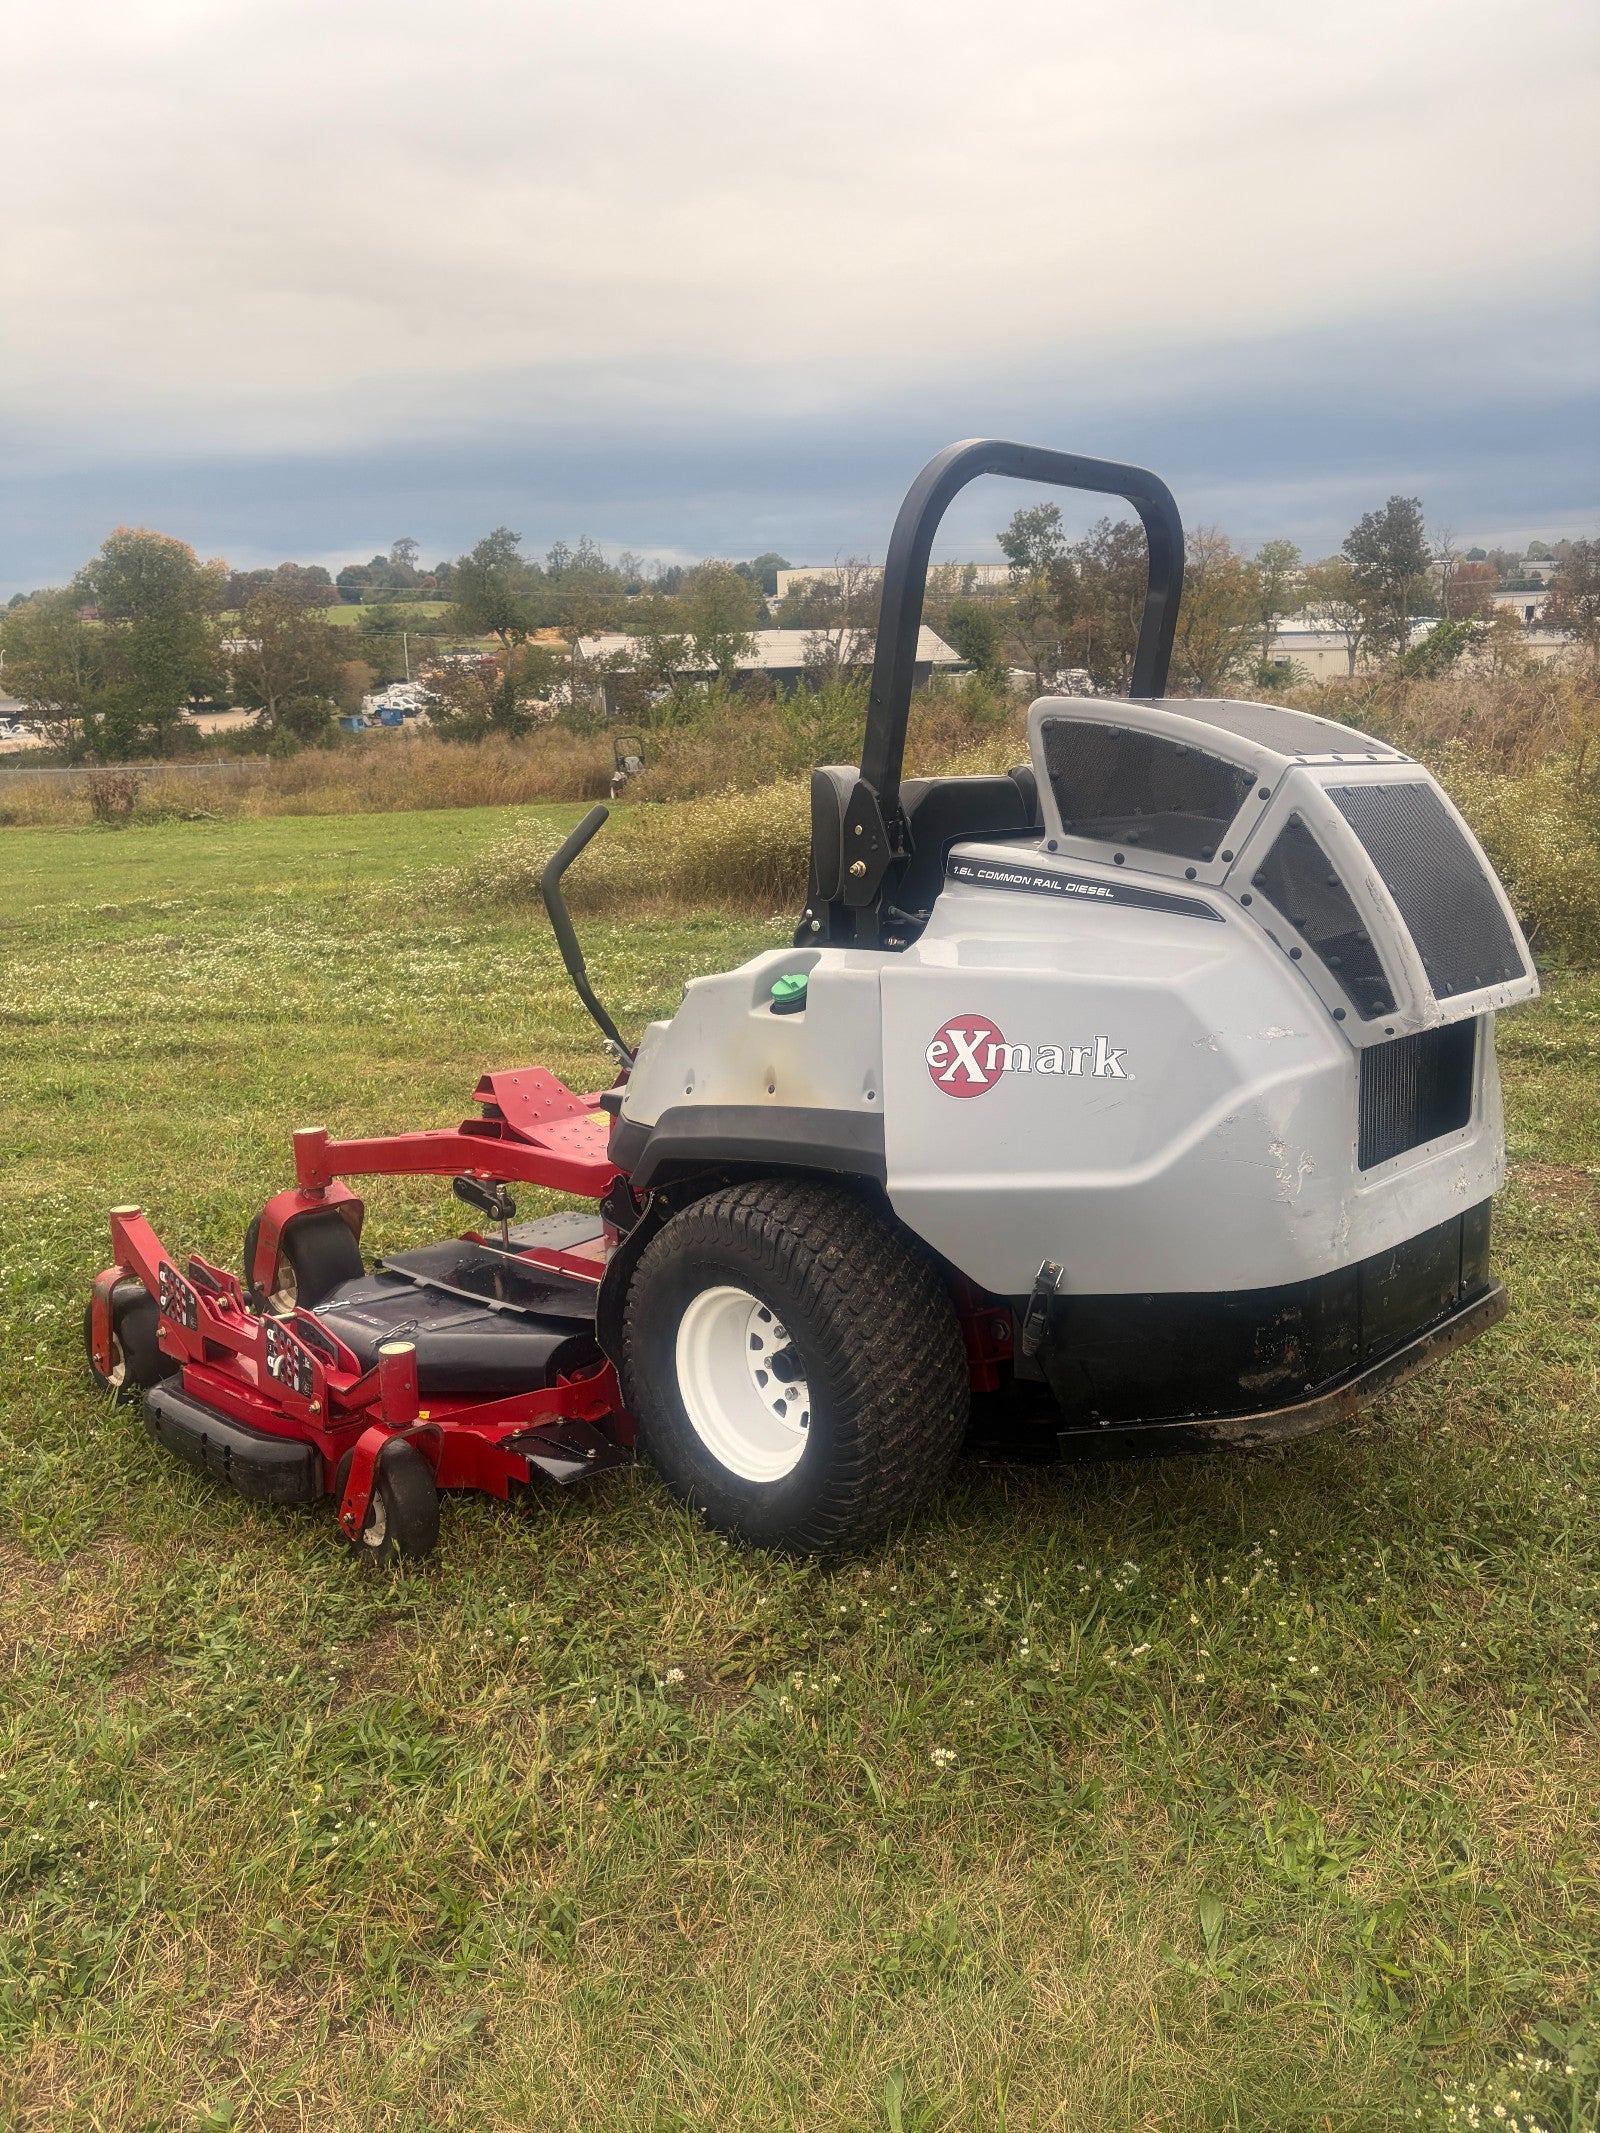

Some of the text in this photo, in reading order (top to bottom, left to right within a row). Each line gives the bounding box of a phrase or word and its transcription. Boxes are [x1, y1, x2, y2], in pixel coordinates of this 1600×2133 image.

[953, 866, 1114, 898] 1.6L COMMON RAIL DIESEL
